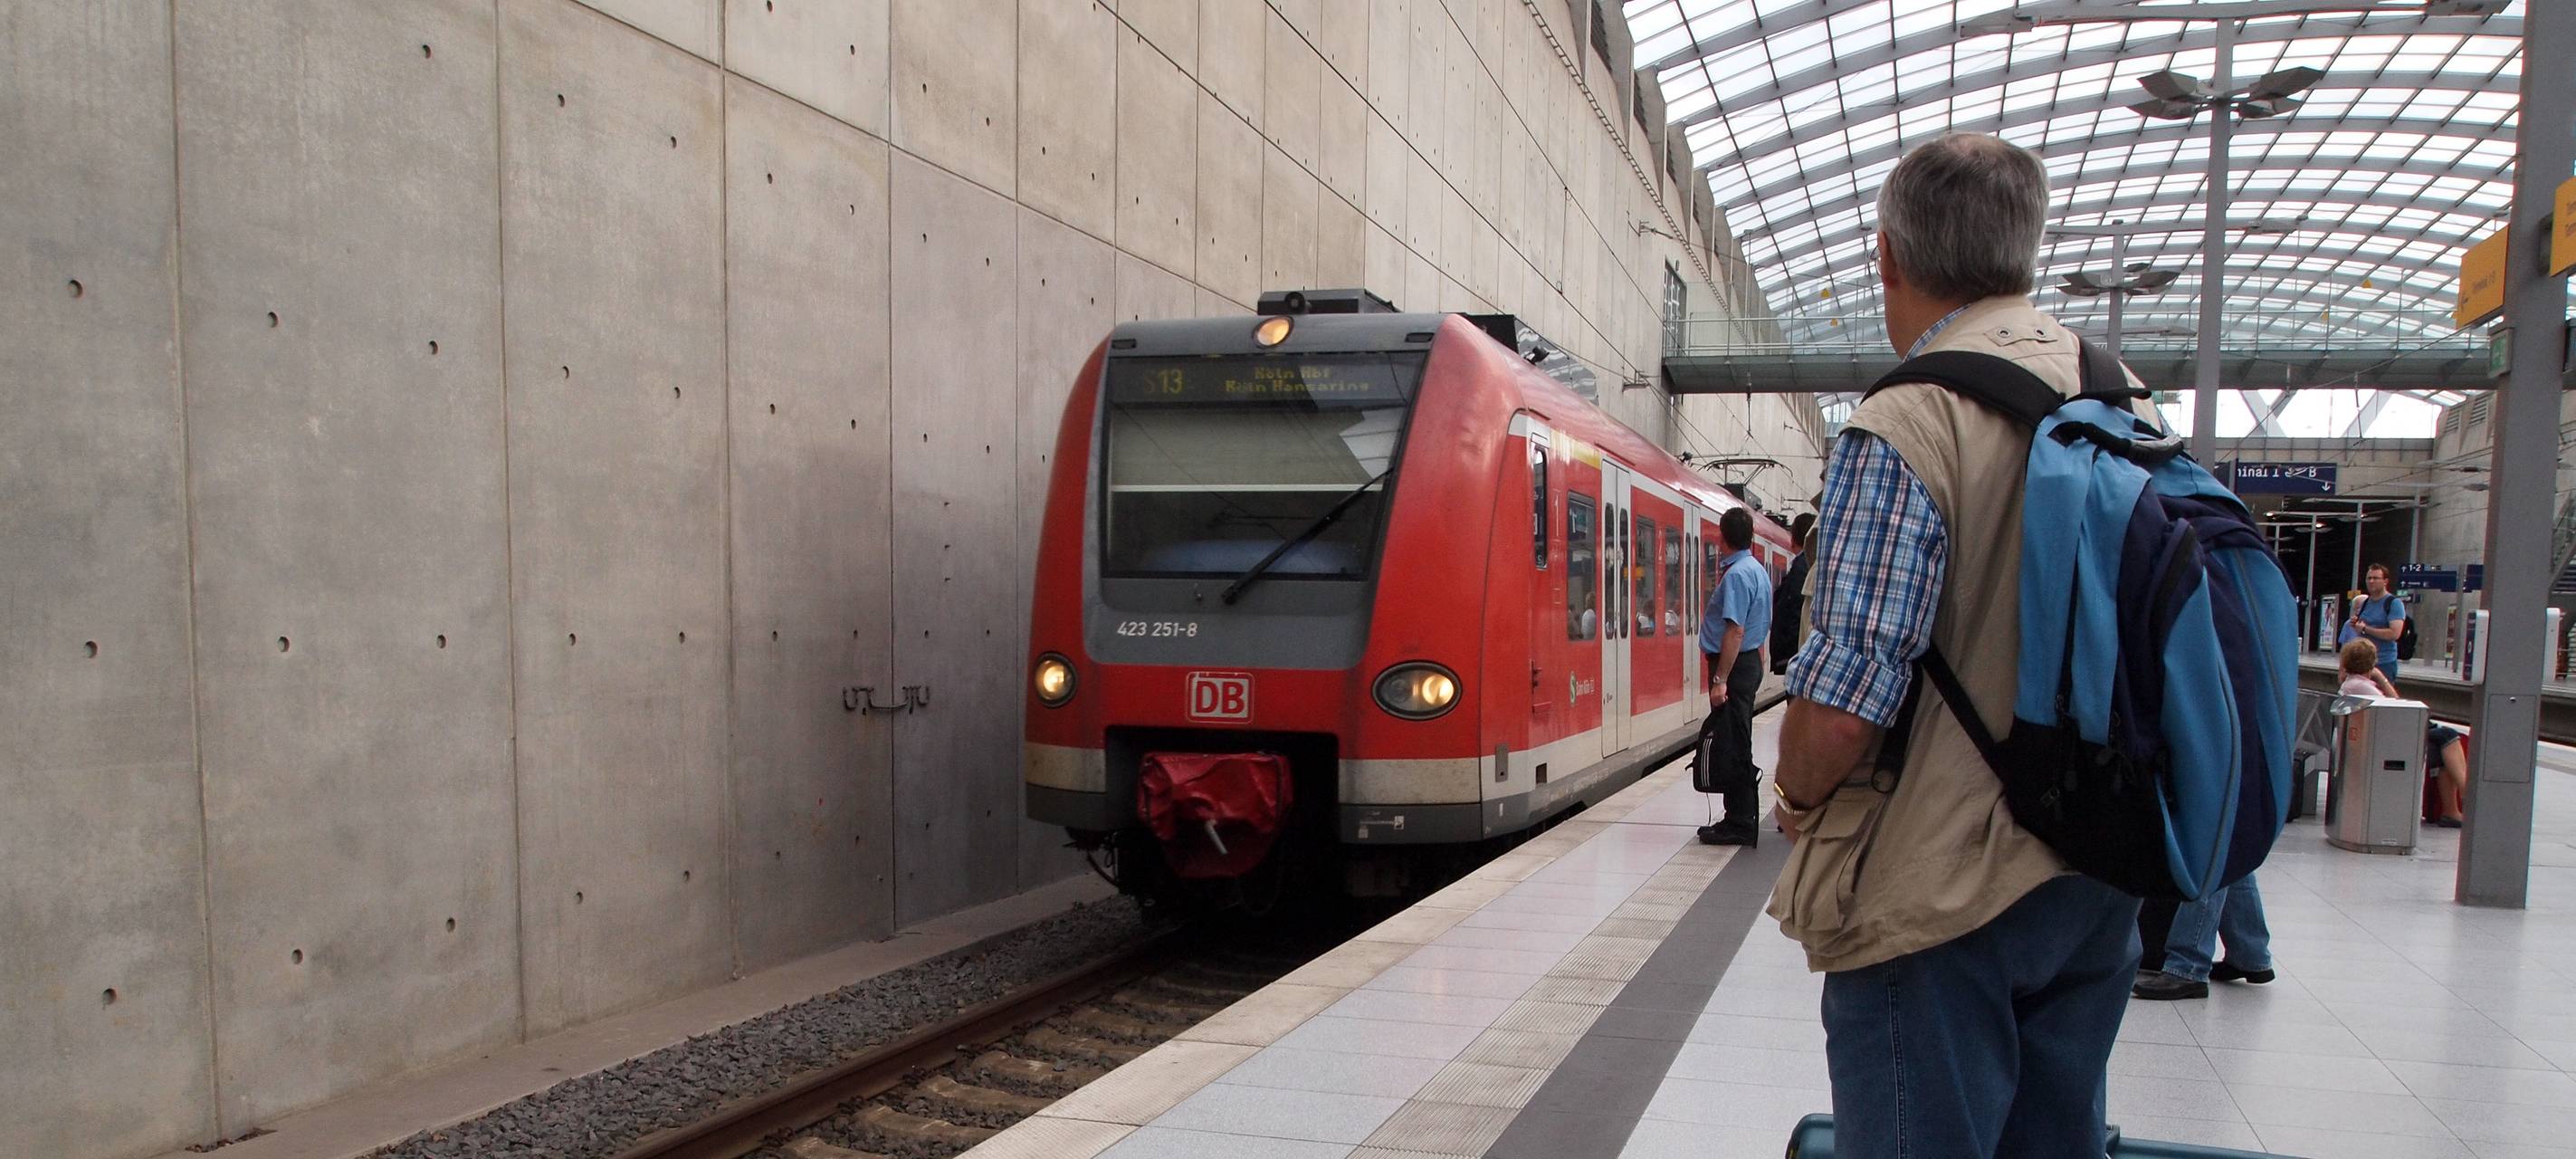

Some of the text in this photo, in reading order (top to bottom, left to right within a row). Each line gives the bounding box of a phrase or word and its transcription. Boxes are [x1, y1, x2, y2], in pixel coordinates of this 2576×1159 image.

[1301, 365, 1332, 378] Hbf
[1117, 620, 1198, 637] 423 251-8
[1195, 680, 1245, 714] DB
